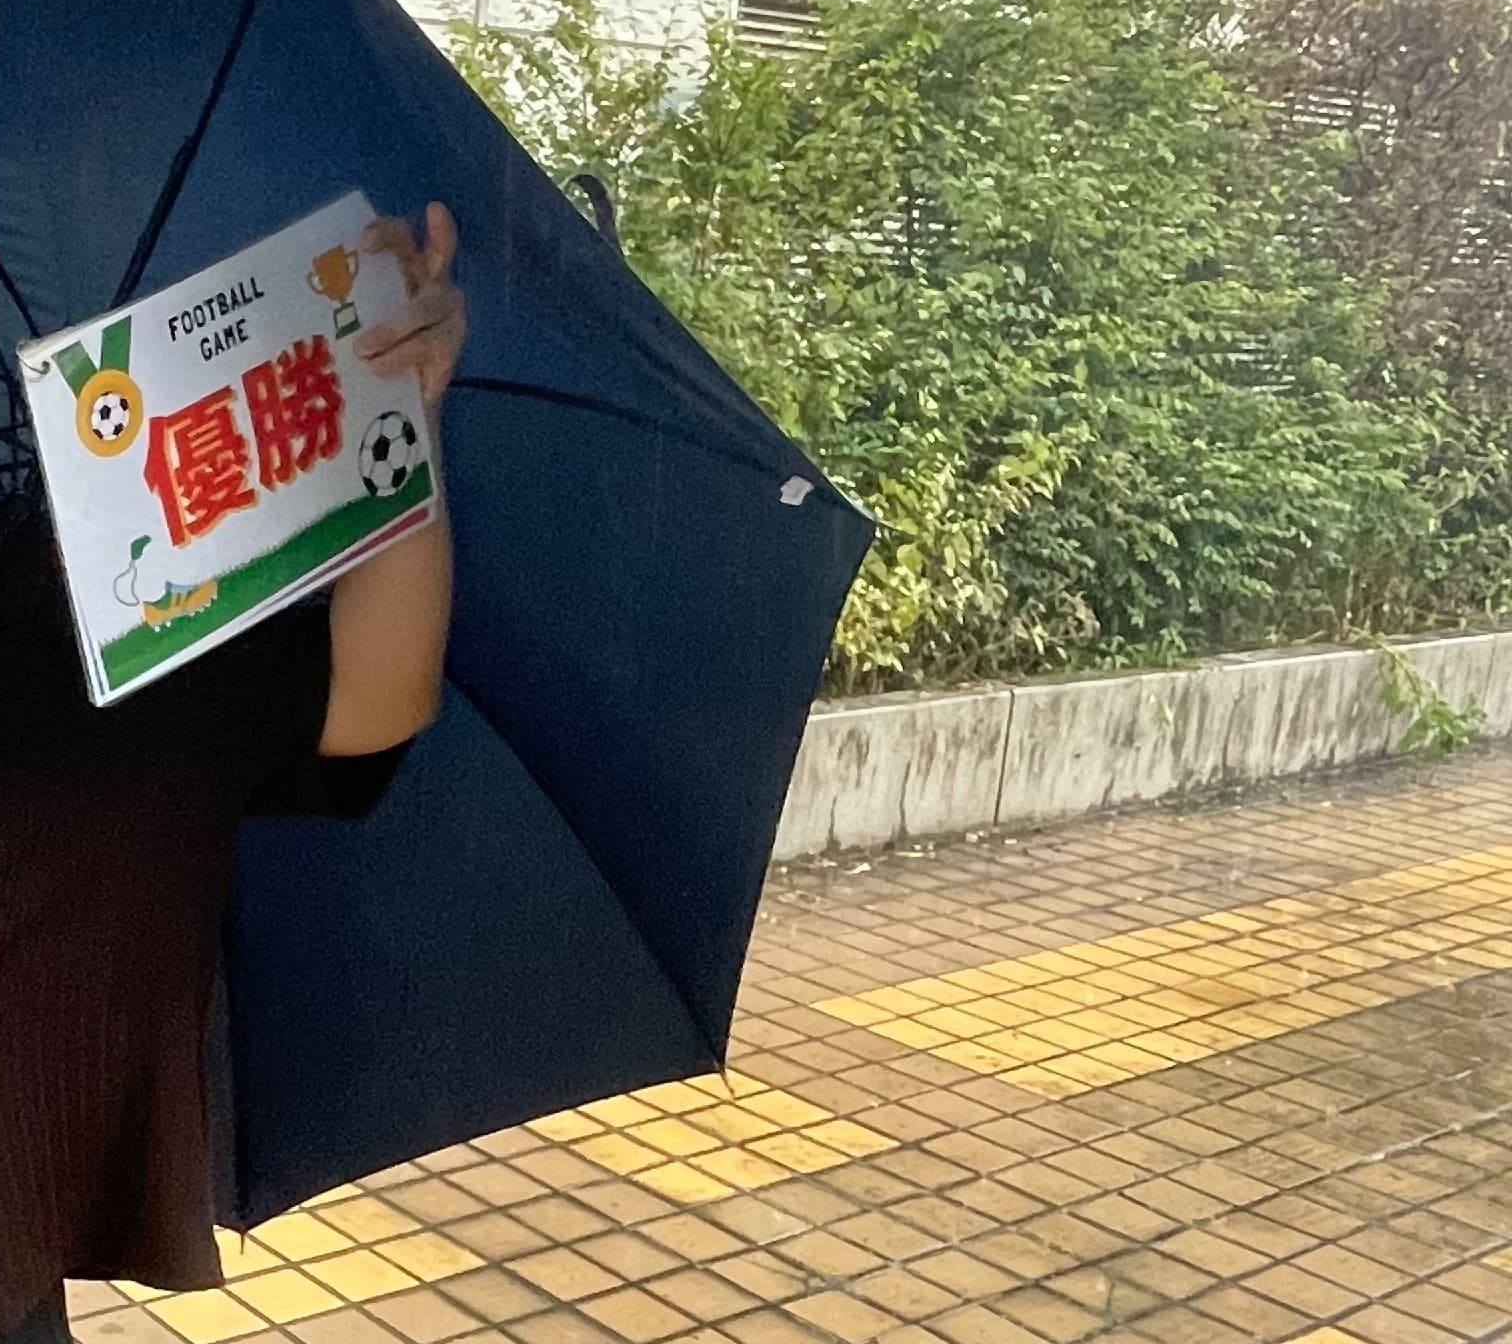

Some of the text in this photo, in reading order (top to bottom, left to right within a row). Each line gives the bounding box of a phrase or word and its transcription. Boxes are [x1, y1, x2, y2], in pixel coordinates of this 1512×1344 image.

[168, 275, 265, 342] FOOTBALL
[200, 318, 249, 362] GAME
[143, 334, 345, 548] 優勝
